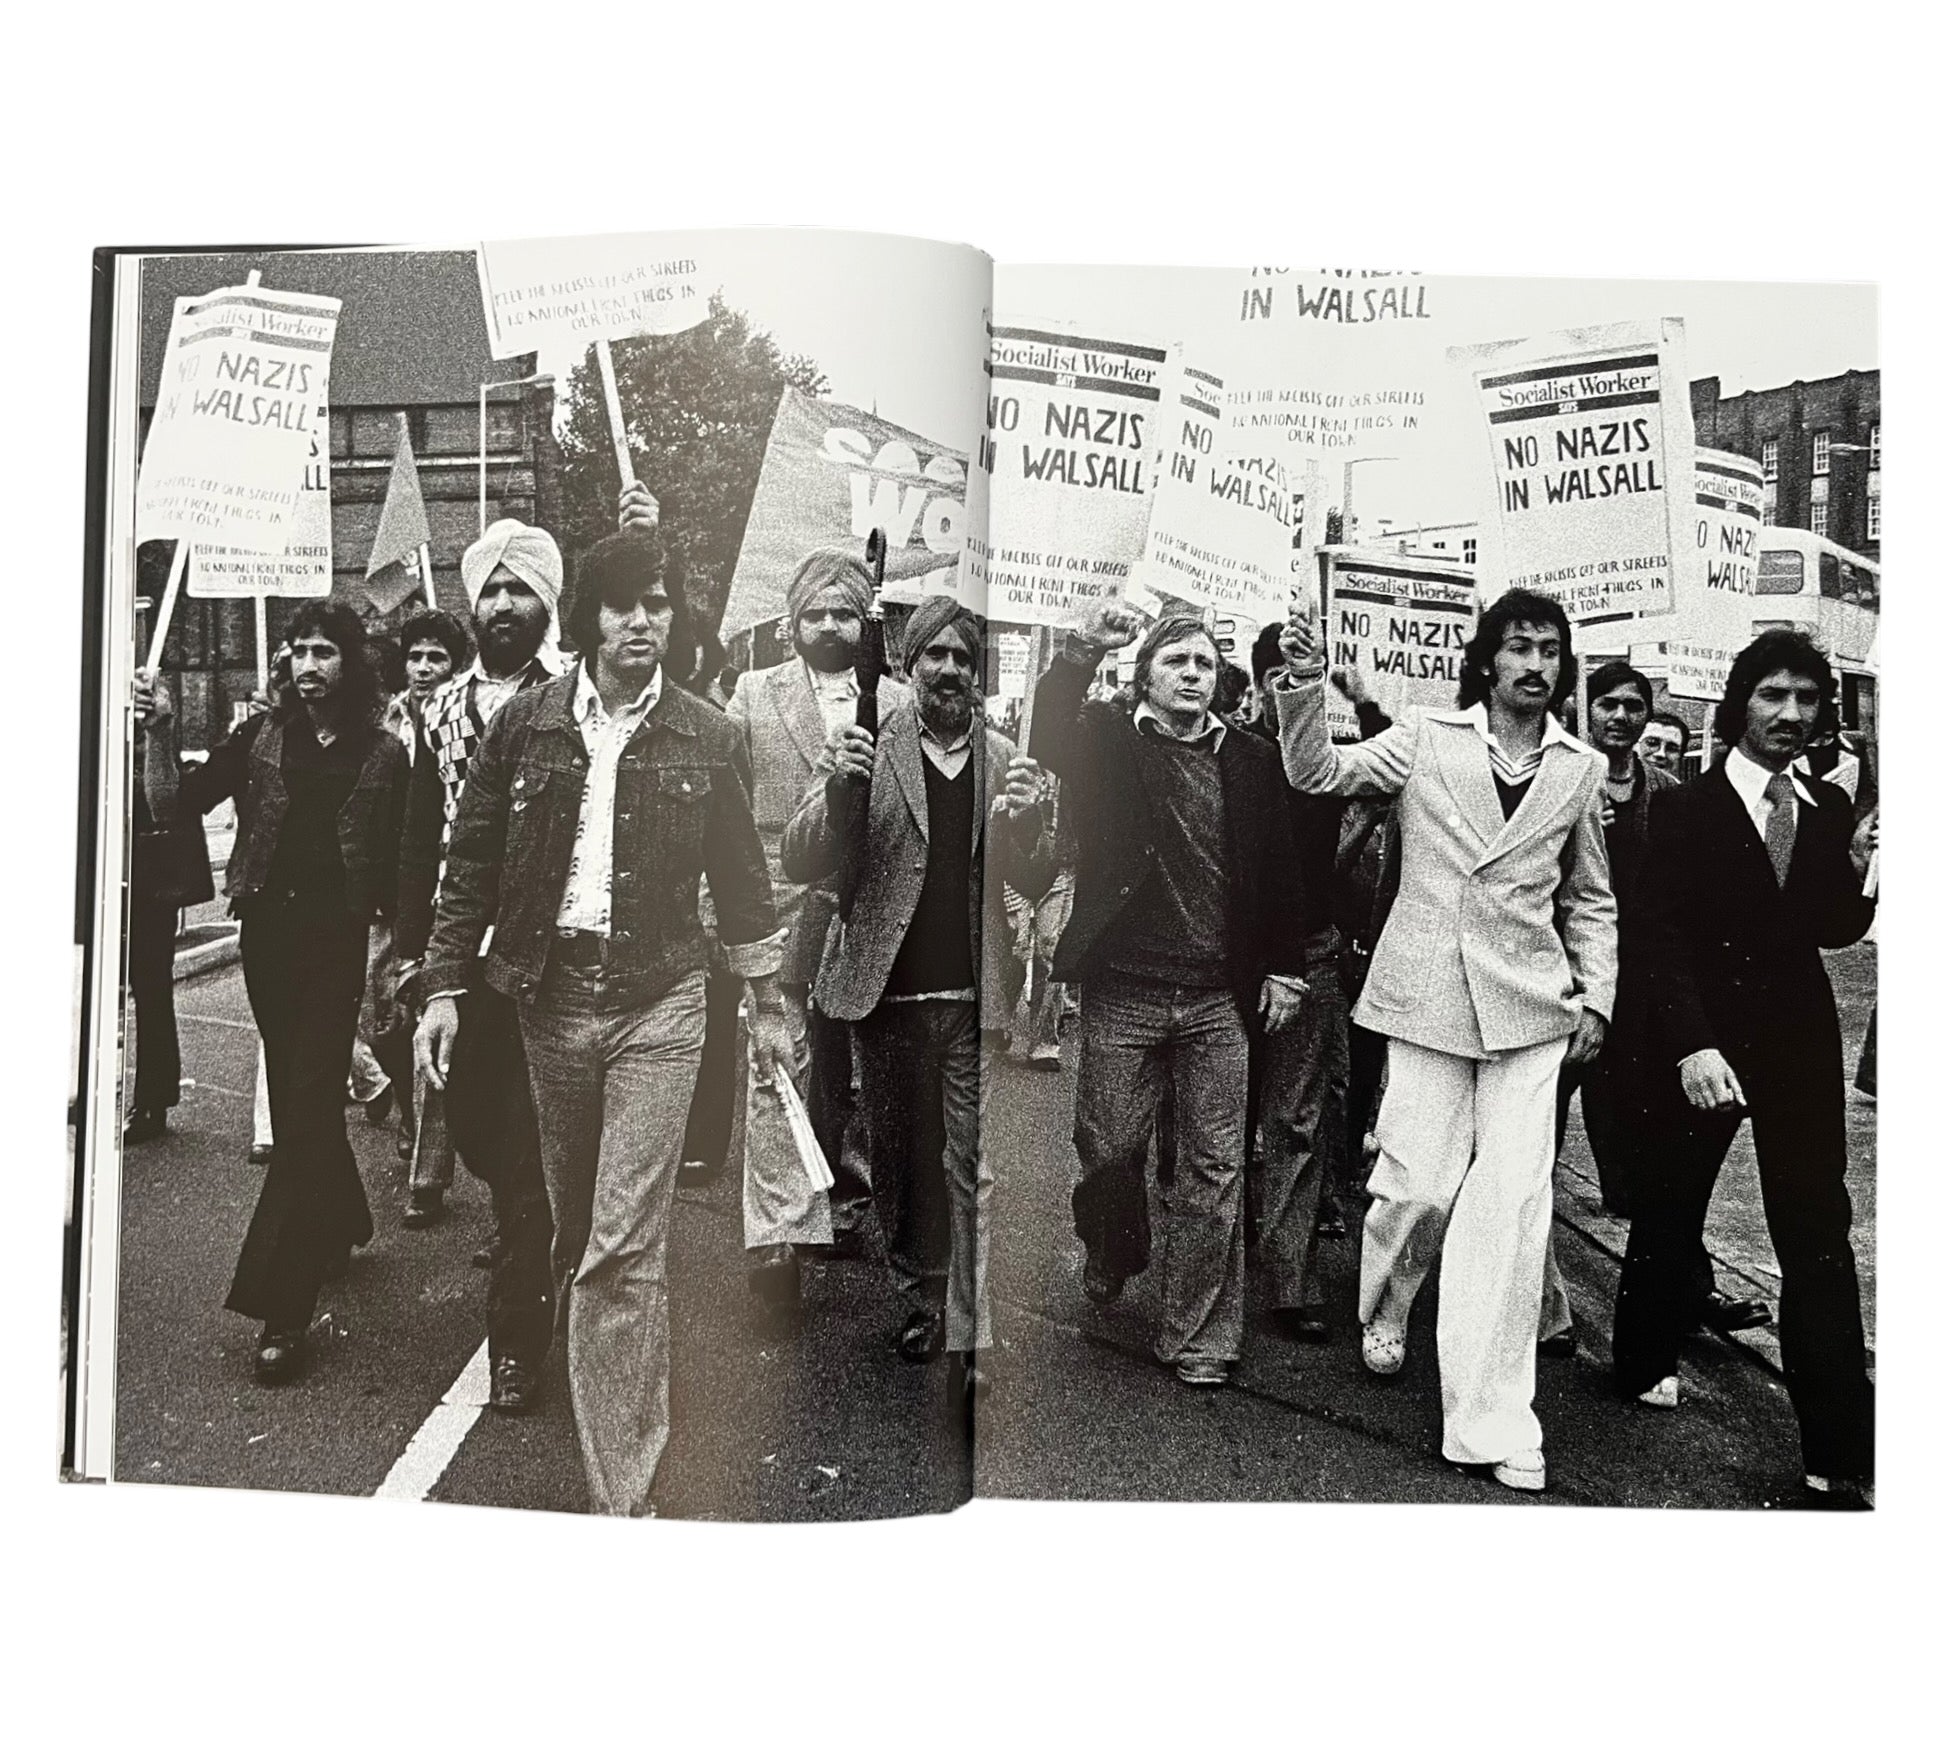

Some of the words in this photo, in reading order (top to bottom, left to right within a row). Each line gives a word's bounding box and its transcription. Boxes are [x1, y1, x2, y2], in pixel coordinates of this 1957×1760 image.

[650, 259, 697, 278] STREETS
[634, 286, 675, 304] THUGS
[681, 284, 696, 299] IN
[1240, 286, 1272, 321] IN
[1297, 284, 1431, 323] WALSALL
[261, 311, 328, 339] Worker
[216, 351, 312, 394] NAZIS
[991, 340, 1078, 372] Socialist
[1083, 352, 1157, 384] Worker
[1498, 380, 1577, 408] Socialist
[1578, 372, 1652, 397] Worker
[193, 387, 308, 432] WALSALL
[1045, 401, 1145, 450] NAZIS
[1403, 415, 1419, 430] IN
[1182, 420, 1213, 454] NO
[1288, 429, 1315, 445] OUR
[1504, 435, 1539, 471] NO
[1556, 417, 1651, 463] NAZIS
[1022, 444, 1145, 495] WALSALL
[1171, 451, 1196, 483] IN
[1210, 467, 1291, 528] WALSALL
[1504, 478, 1530, 513] IN
[1544, 459, 1663, 505] WALSALL
[314, 563, 326, 575] IN
[1066, 556, 1089, 574] OUR
[1597, 560, 1620, 574] OUR
[1622, 555, 1668, 572] STREETS
[1008, 588, 1034, 604] OUR
[1346, 572, 1410, 597] Socialist
[1412, 581, 1470, 602] Worker
[1650, 577, 1665, 590] IN
[1340, 610, 1370, 638] NO
[1389, 617, 1465, 650] NAZIS
[1334, 641, 1359, 666] IN
